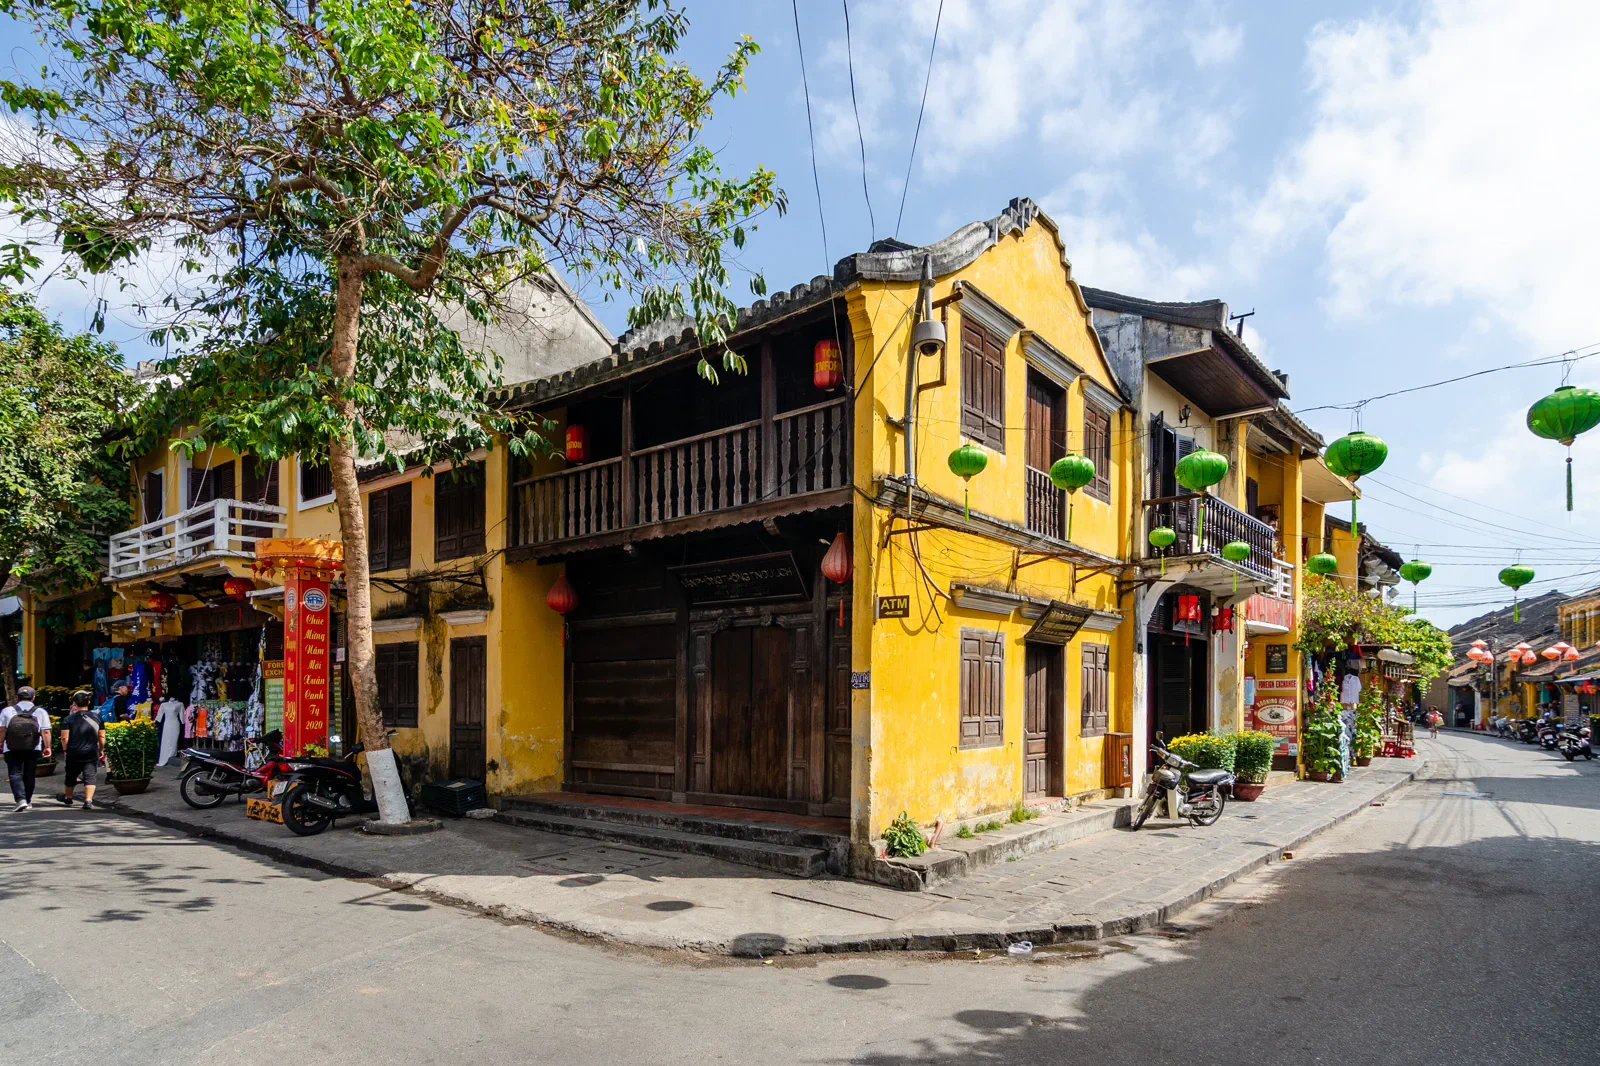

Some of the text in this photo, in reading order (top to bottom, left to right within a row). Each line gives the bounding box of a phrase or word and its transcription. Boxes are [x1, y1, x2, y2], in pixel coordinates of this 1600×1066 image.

[880, 598, 908, 610] ATM
[265, 669, 284, 677] EXCH
[851, 672, 870, 683] ATM
[1258, 680, 1297, 688] FOREIGN EXCHANGE
[304, 689, 324, 700] Canh
[1256, 698, 1296, 707] BOOKING OFFICE
[305, 720, 323, 730] 2020
